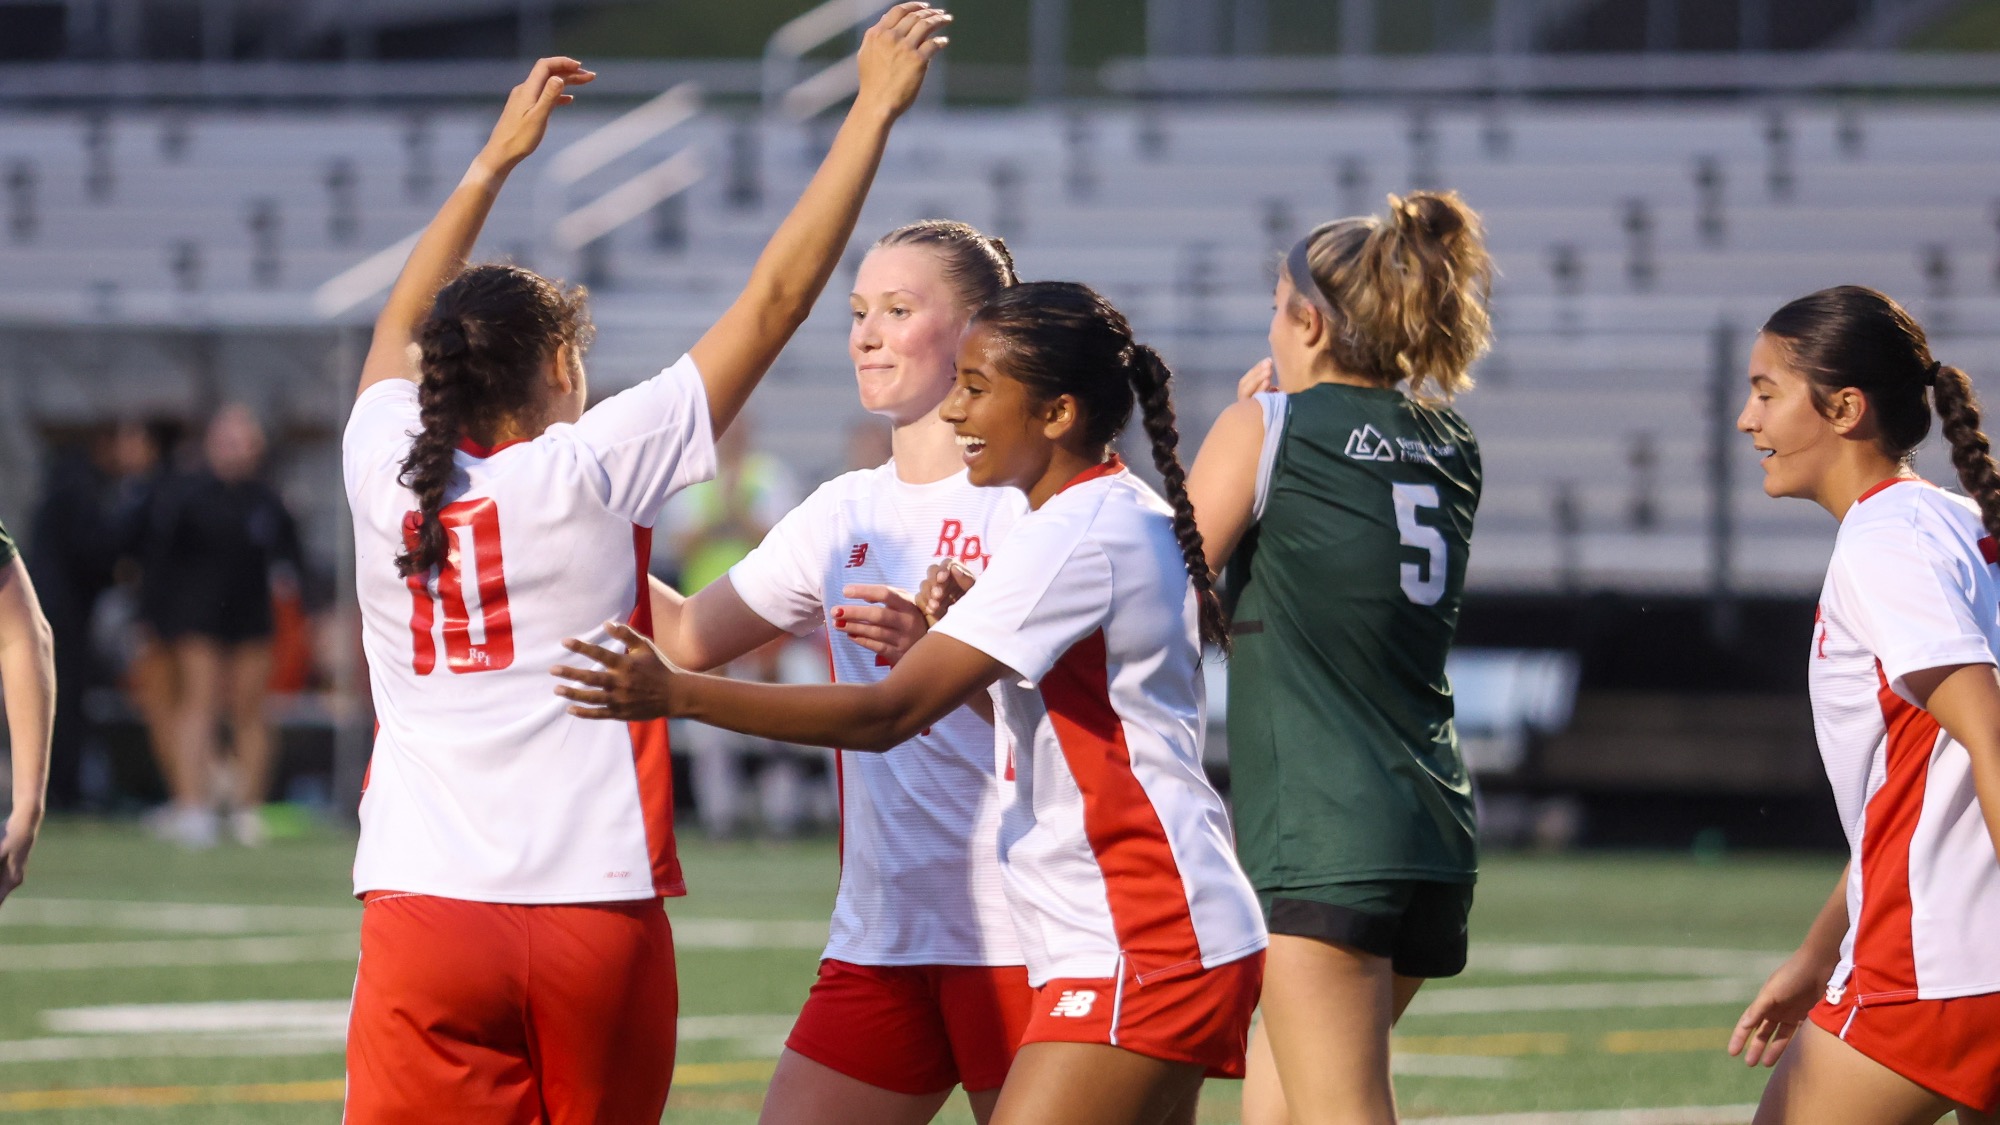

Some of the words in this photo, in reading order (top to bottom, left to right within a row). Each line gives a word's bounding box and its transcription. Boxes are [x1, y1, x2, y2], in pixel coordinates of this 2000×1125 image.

[1392, 482, 1447, 606] 5
[402, 497, 514, 676] 10
[469, 647, 491, 667] RPI
[1049, 990, 1097, 1017] NB
